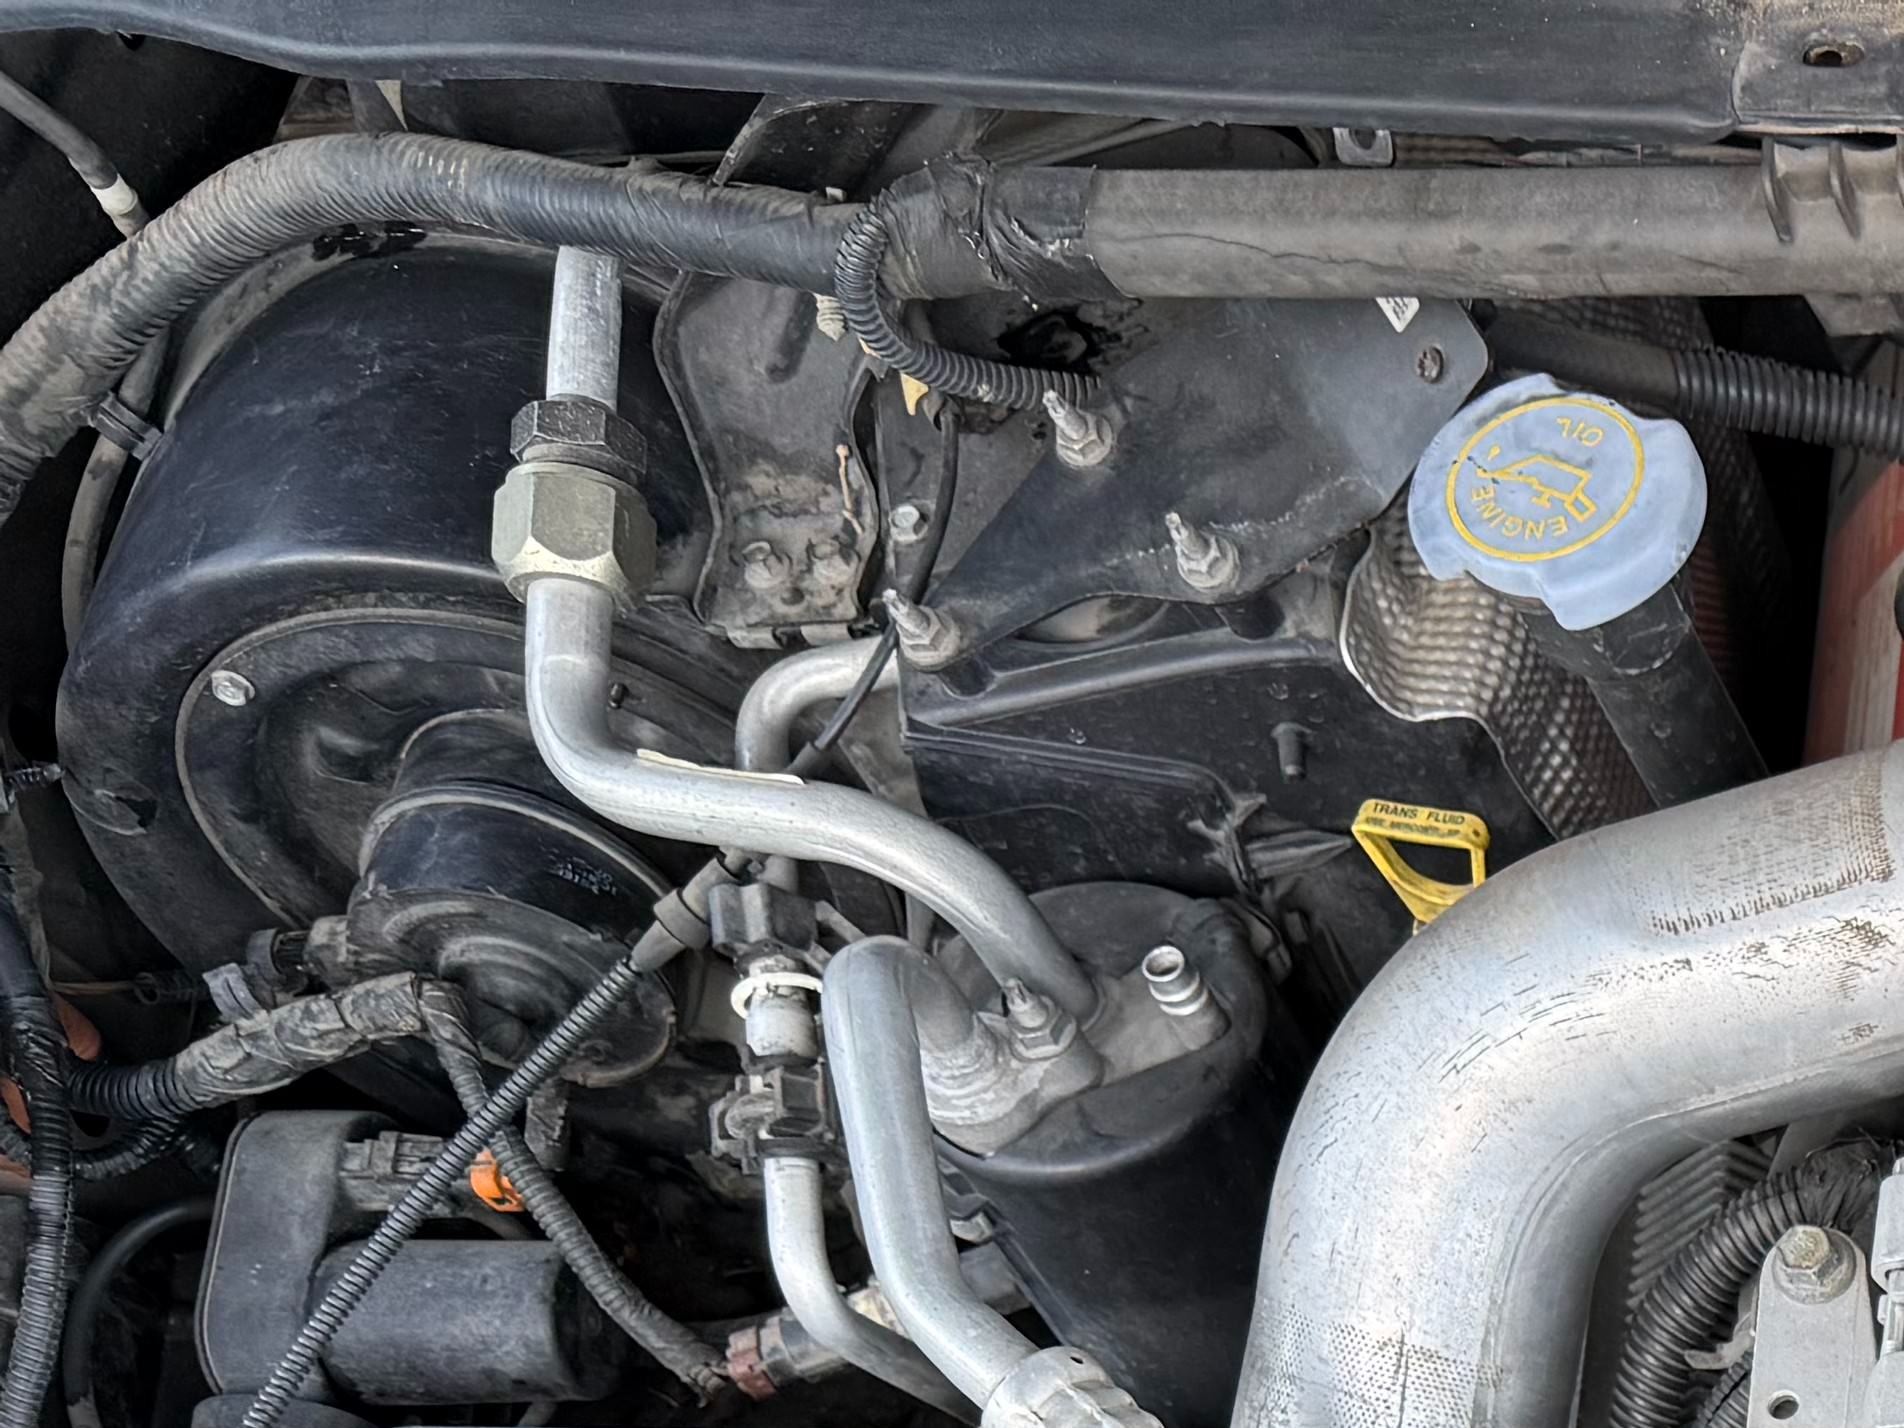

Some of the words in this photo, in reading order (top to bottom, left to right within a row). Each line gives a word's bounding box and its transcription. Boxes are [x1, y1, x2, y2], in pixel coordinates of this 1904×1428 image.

[1555, 417, 1604, 447] OIL
[1470, 485, 1568, 540] ENGINE
[1373, 803, 1418, 819] TRANS
[1426, 811, 1465, 825] FLUID
